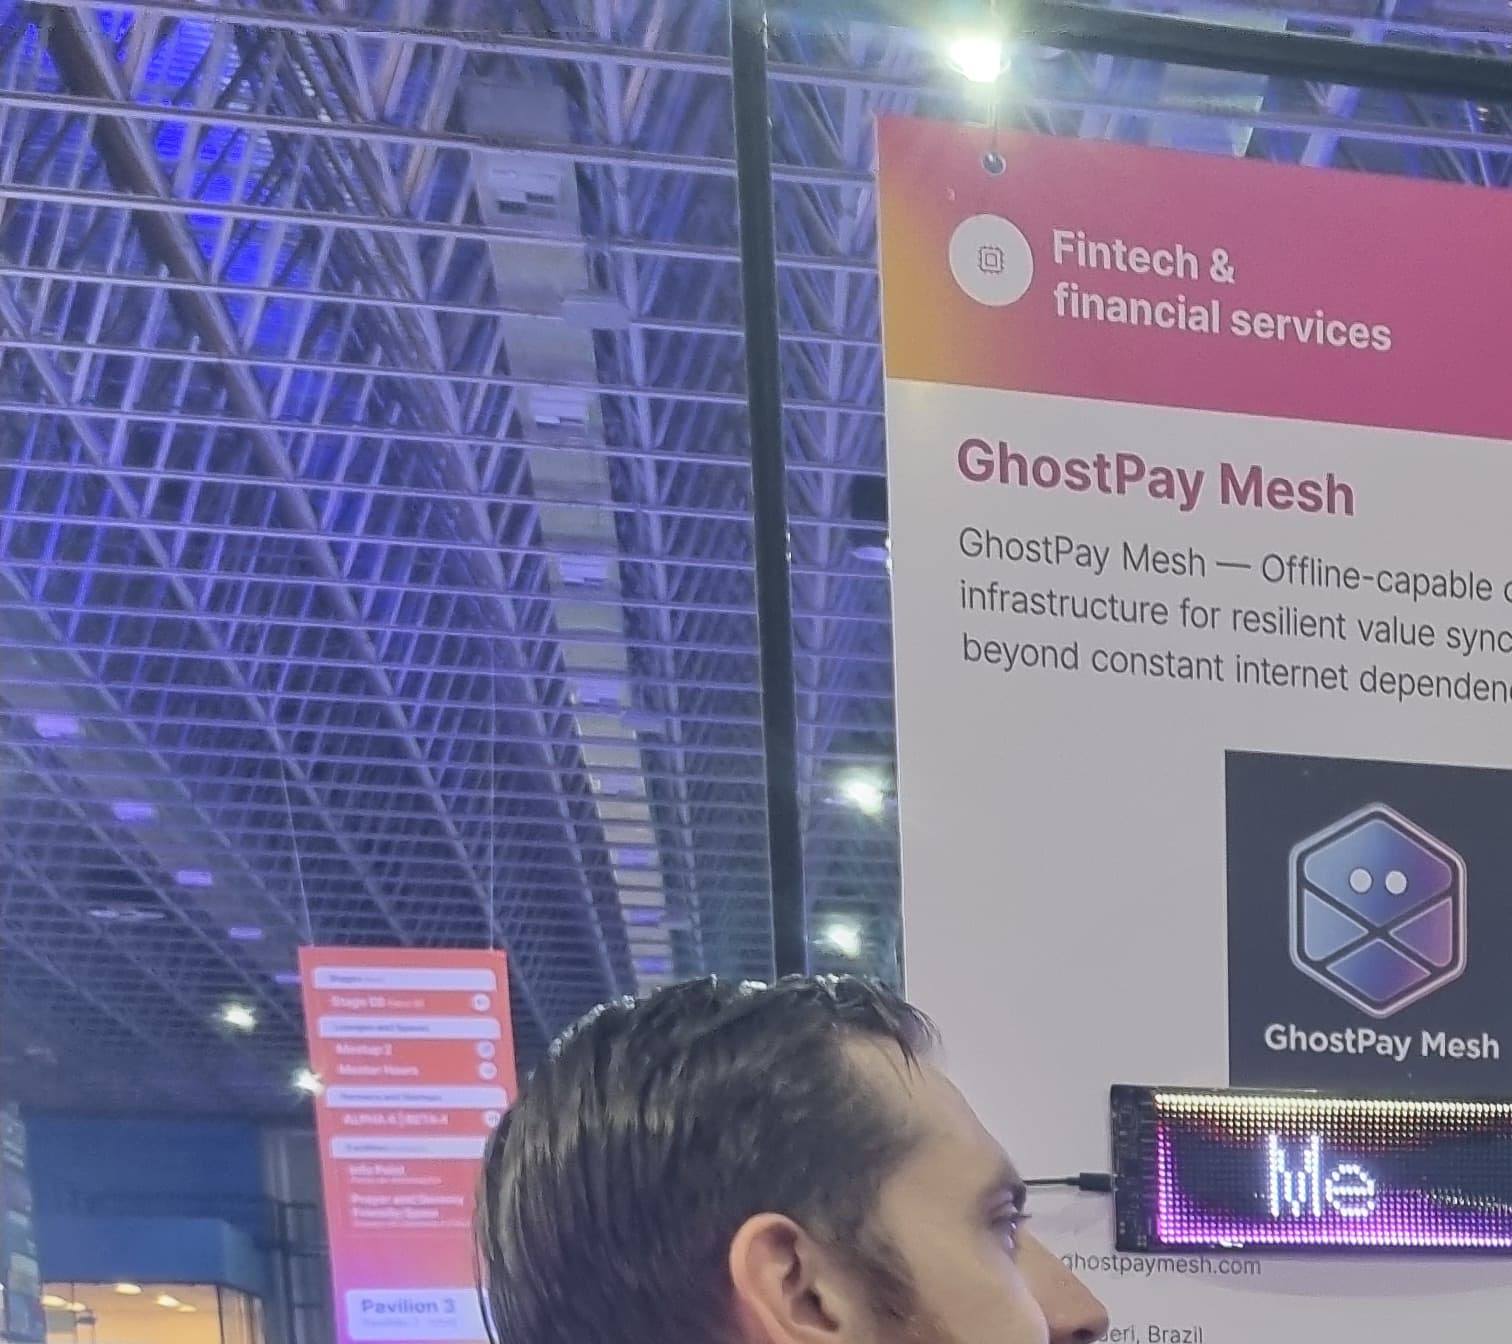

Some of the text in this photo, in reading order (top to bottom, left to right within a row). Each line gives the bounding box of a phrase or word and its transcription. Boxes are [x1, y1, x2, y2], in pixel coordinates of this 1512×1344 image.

[1052, 229, 1236, 284] Fintech &
[1053, 281, 1393, 352] financial services
[957, 437, 1355, 516] GhostPay Mesh
[959, 526, 1111, 576] GhostPay
[1122, 541, 1207, 578] Mesh
[1261, 553, 1493, 602] Offline-capable
[959, 579, 1169, 625] infrastructure
[1179, 597, 1221, 630] for
[1231, 605, 1347, 641] resilient
[1357, 615, 1436, 647] value
[963, 632, 1079, 673] beyond
[1091, 647, 1224, 682] constant
[1235, 654, 1349, 691] internet
[1264, 1023, 1500, 1062] GhostPay Mesh
[1267, 1132, 1376, 1219] Me
[362, 1298, 456, 1314] Pavilion 3
[1148, 1325, 1203, 1344] Brazil
